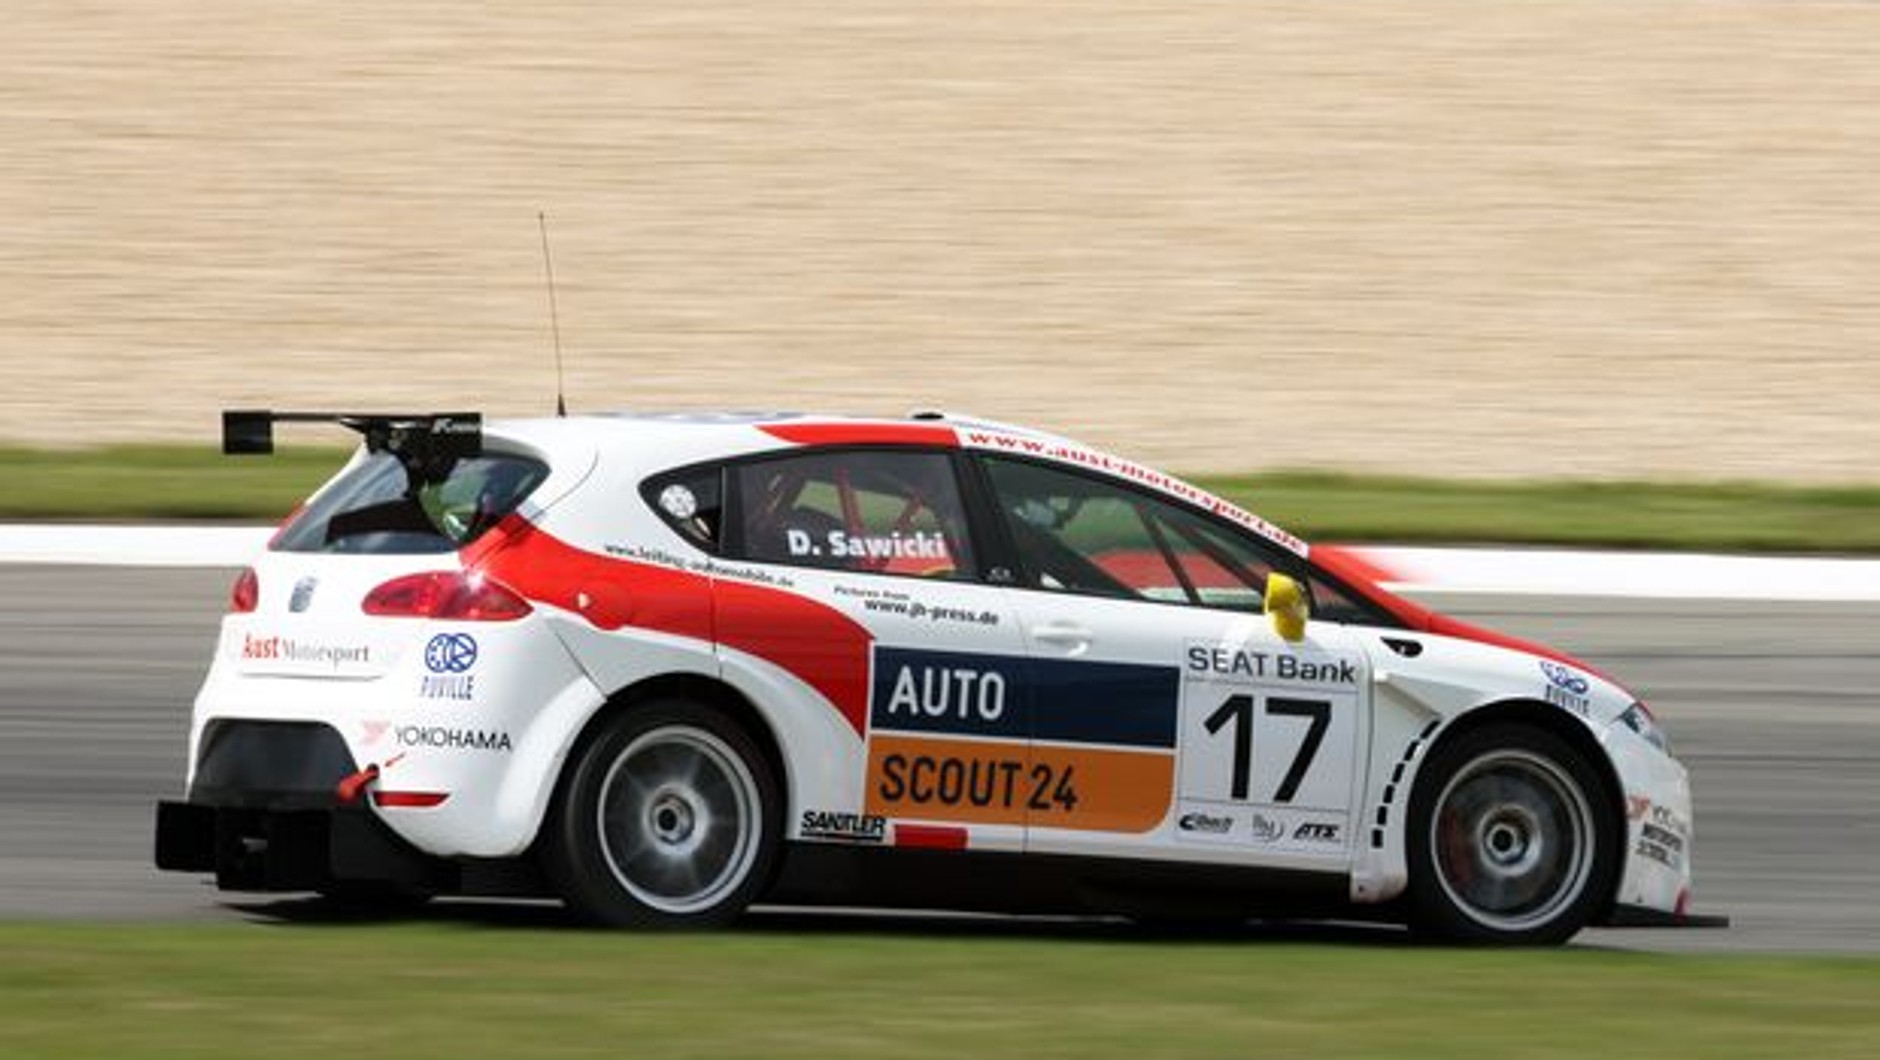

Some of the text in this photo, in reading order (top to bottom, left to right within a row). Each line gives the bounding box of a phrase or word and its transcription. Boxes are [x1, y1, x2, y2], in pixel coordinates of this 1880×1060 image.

[788, 529, 947, 558] D. Sawicki
[1188, 647, 1356, 683] SEAT Bank
[888, 665, 1005, 720] AUTO
[394, 725, 513, 751] YOKOHAMA
[1203, 694, 1333, 803] 17
